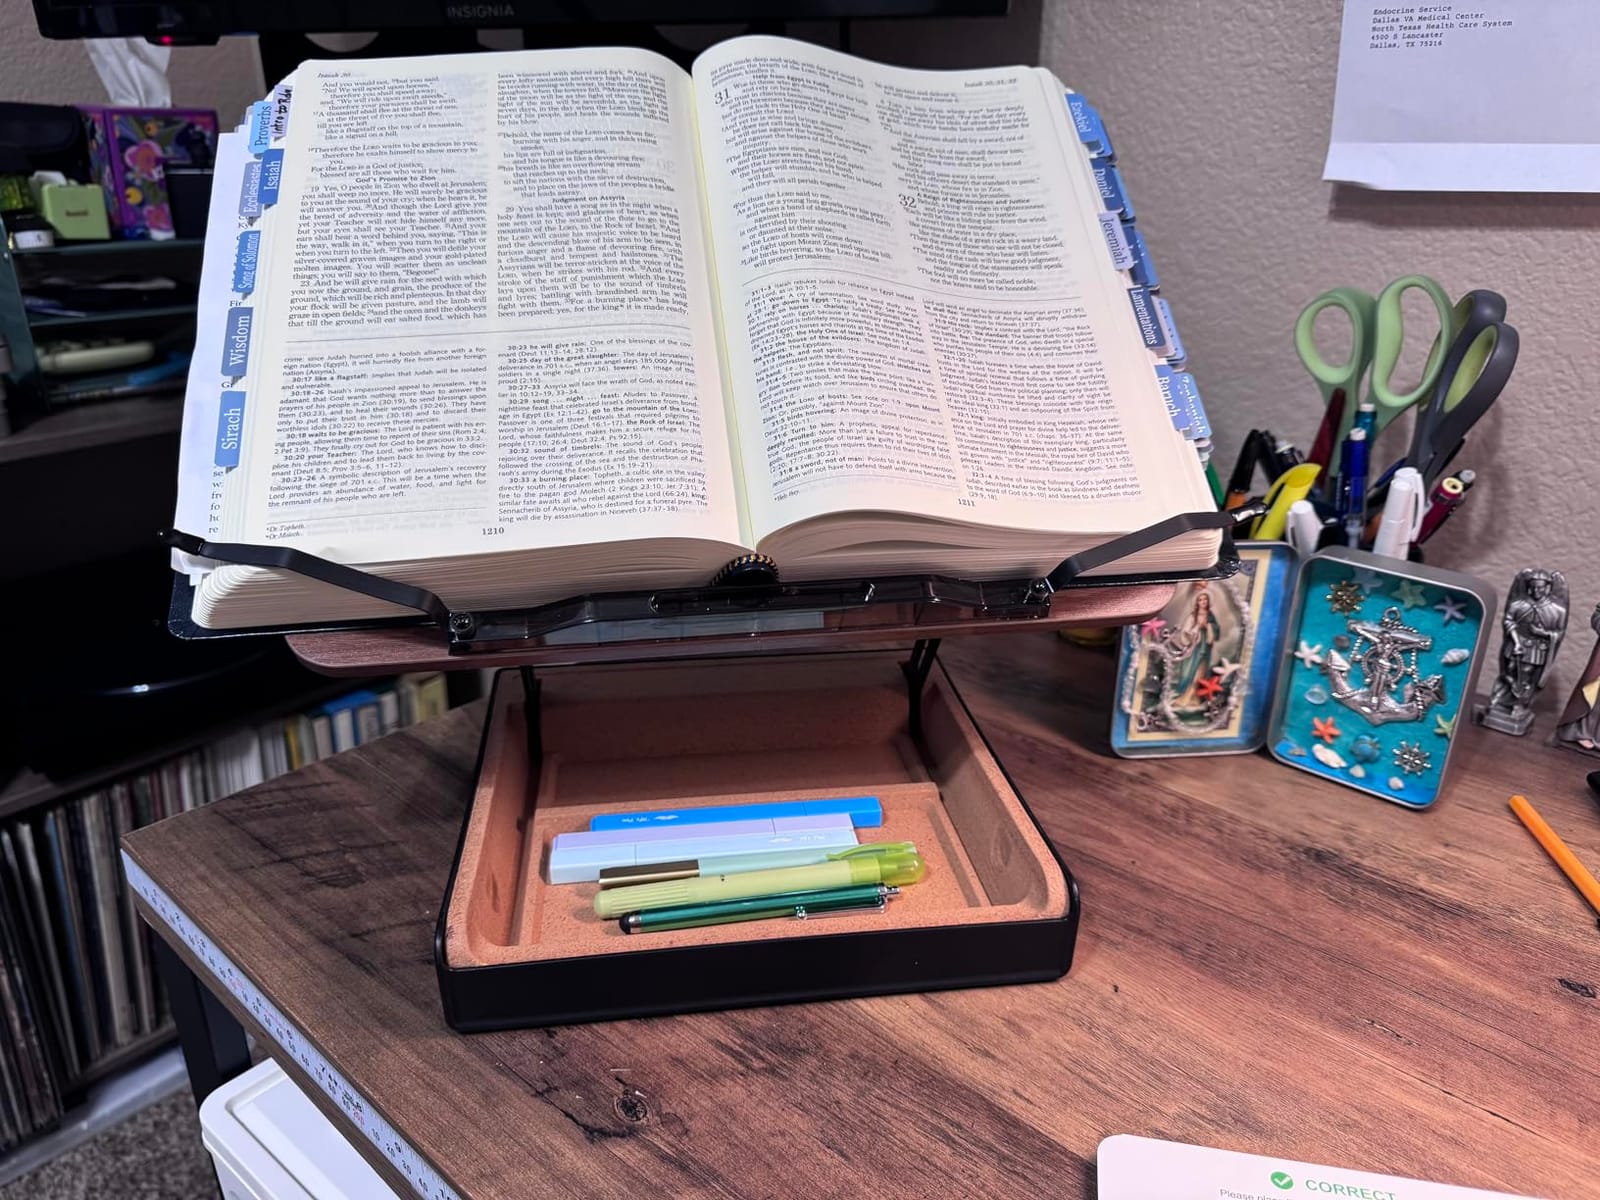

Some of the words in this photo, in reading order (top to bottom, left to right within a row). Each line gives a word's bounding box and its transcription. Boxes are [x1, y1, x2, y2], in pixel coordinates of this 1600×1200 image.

[448, 5, 515, 18] INSIGNIA
[1418, 14, 1450, 22] Medical
[714, 88, 730, 104] 31
[255, 106, 272, 146] Proverbs
[1071, 102, 1091, 133] Ezekiel
[264, 160, 280, 190] Isaiah
[1094, 169, 1115, 200] Daniel
[898, 194, 917, 208] 32
[758, 227, 786, 237] daunted
[241, 233, 259, 262] Solomon
[1102, 218, 1127, 264] Jeremiah
[768, 255, 793, 264] protect
[238, 271, 256, 288] Song
[335, 318, 364, 326] ground
[1130, 289, 1157, 345] Lamentations
[230, 316, 249, 366] Wisdom
[1158, 376, 1181, 417] Baruch
[221, 408, 241, 449] Sirach
[772, 473, 800, 488] Jerusalem
[802, 470, 814, 478] will
[923, 470, 946, 478] because
[336, 494, 359, 502] people
[554, 511, 598, 519] assassination
[482, 527, 504, 535] 1210
[1220, 1189, 1255, 1200] Please
[1305, 1179, 1396, 1200] CORRECT
